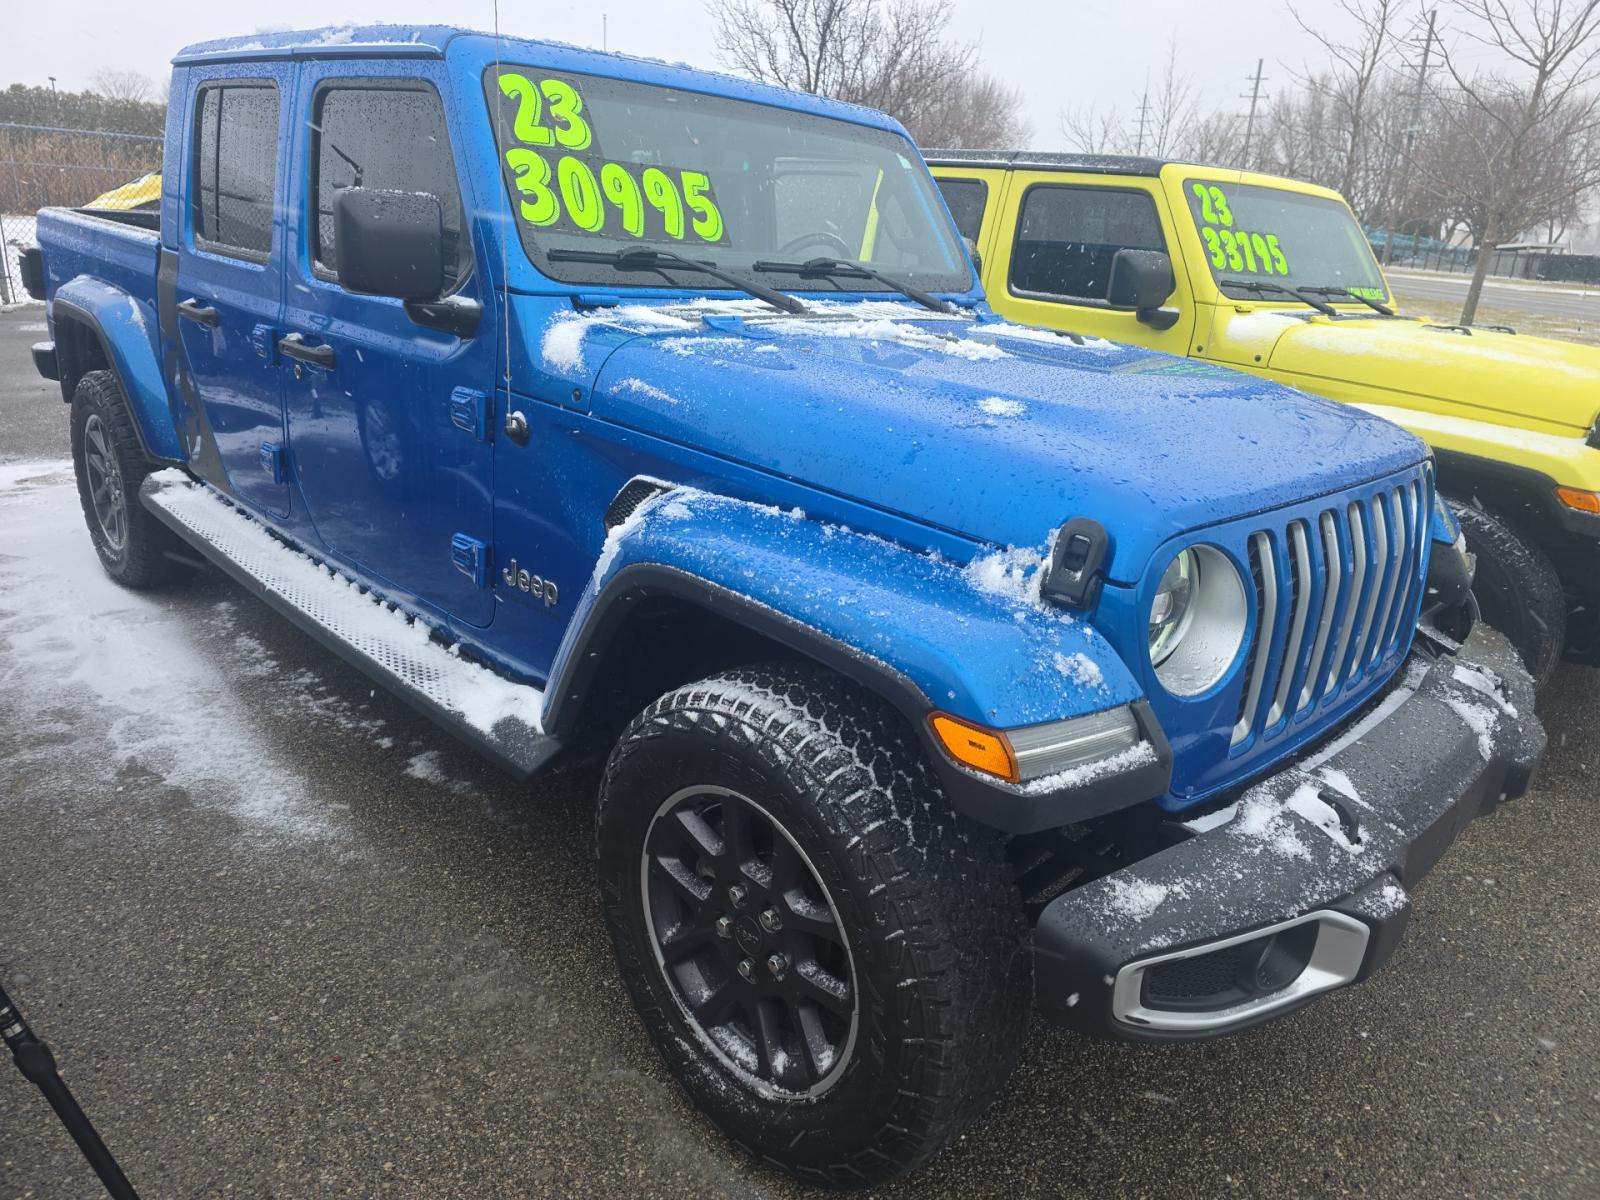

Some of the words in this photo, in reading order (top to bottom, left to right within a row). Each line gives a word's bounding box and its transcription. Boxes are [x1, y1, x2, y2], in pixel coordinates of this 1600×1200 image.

[498, 73, 592, 150] 23
[505, 148, 724, 242] 30995
[1192, 183, 1233, 227] 23
[1201, 226, 1288, 276] 33795
[502, 557, 559, 608] Jeep
